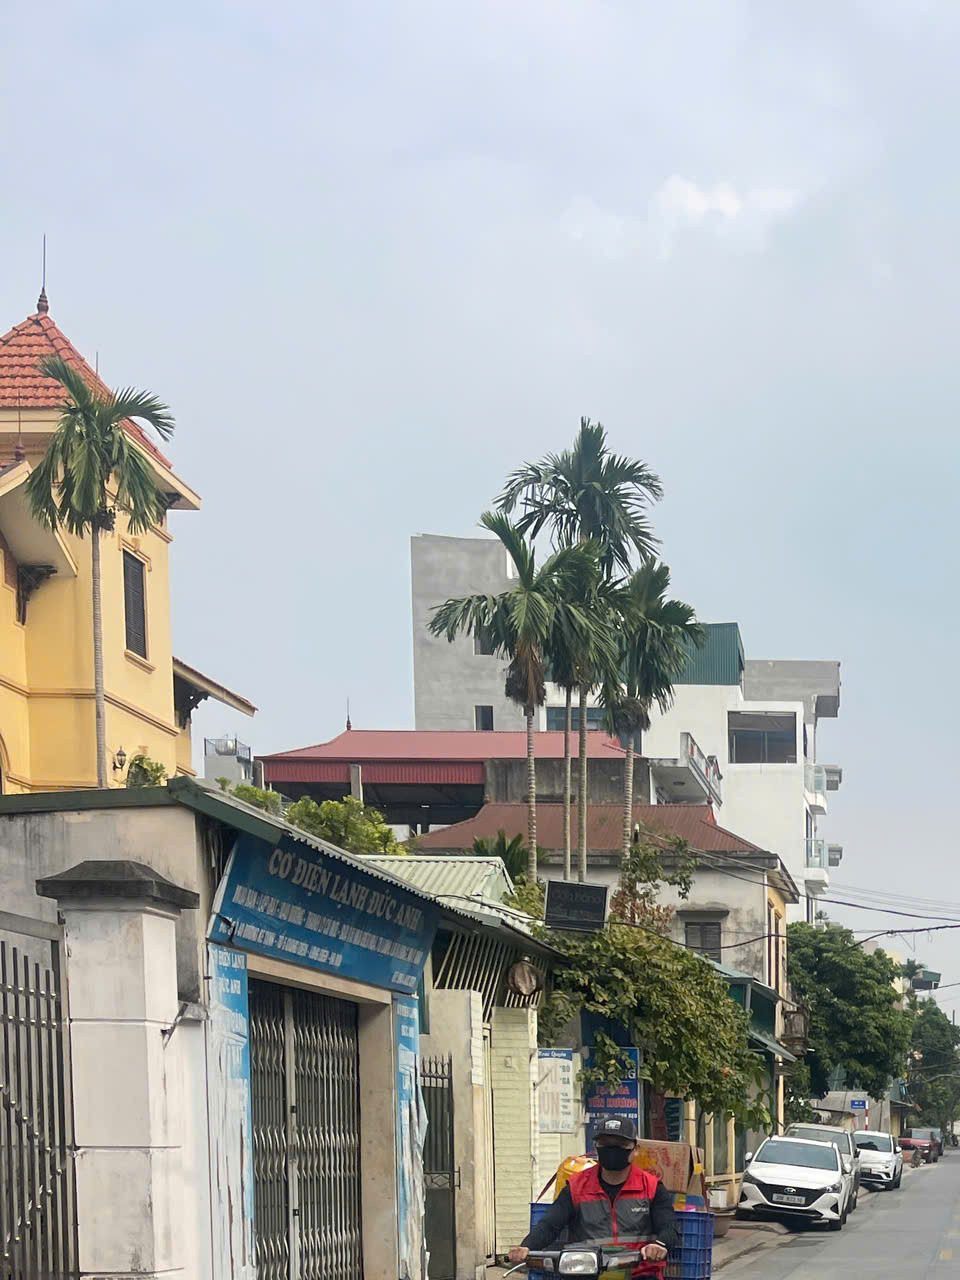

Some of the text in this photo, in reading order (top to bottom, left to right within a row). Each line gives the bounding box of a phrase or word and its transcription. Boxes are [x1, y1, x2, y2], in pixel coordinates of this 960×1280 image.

[268, 849, 296, 879] CƠ
[292, 858, 333, 897] ĐIỆN
[330, 875, 368, 914] LẠNH
[367, 889, 396, 920] ĐỨC
[395, 904, 422, 931] ANH
